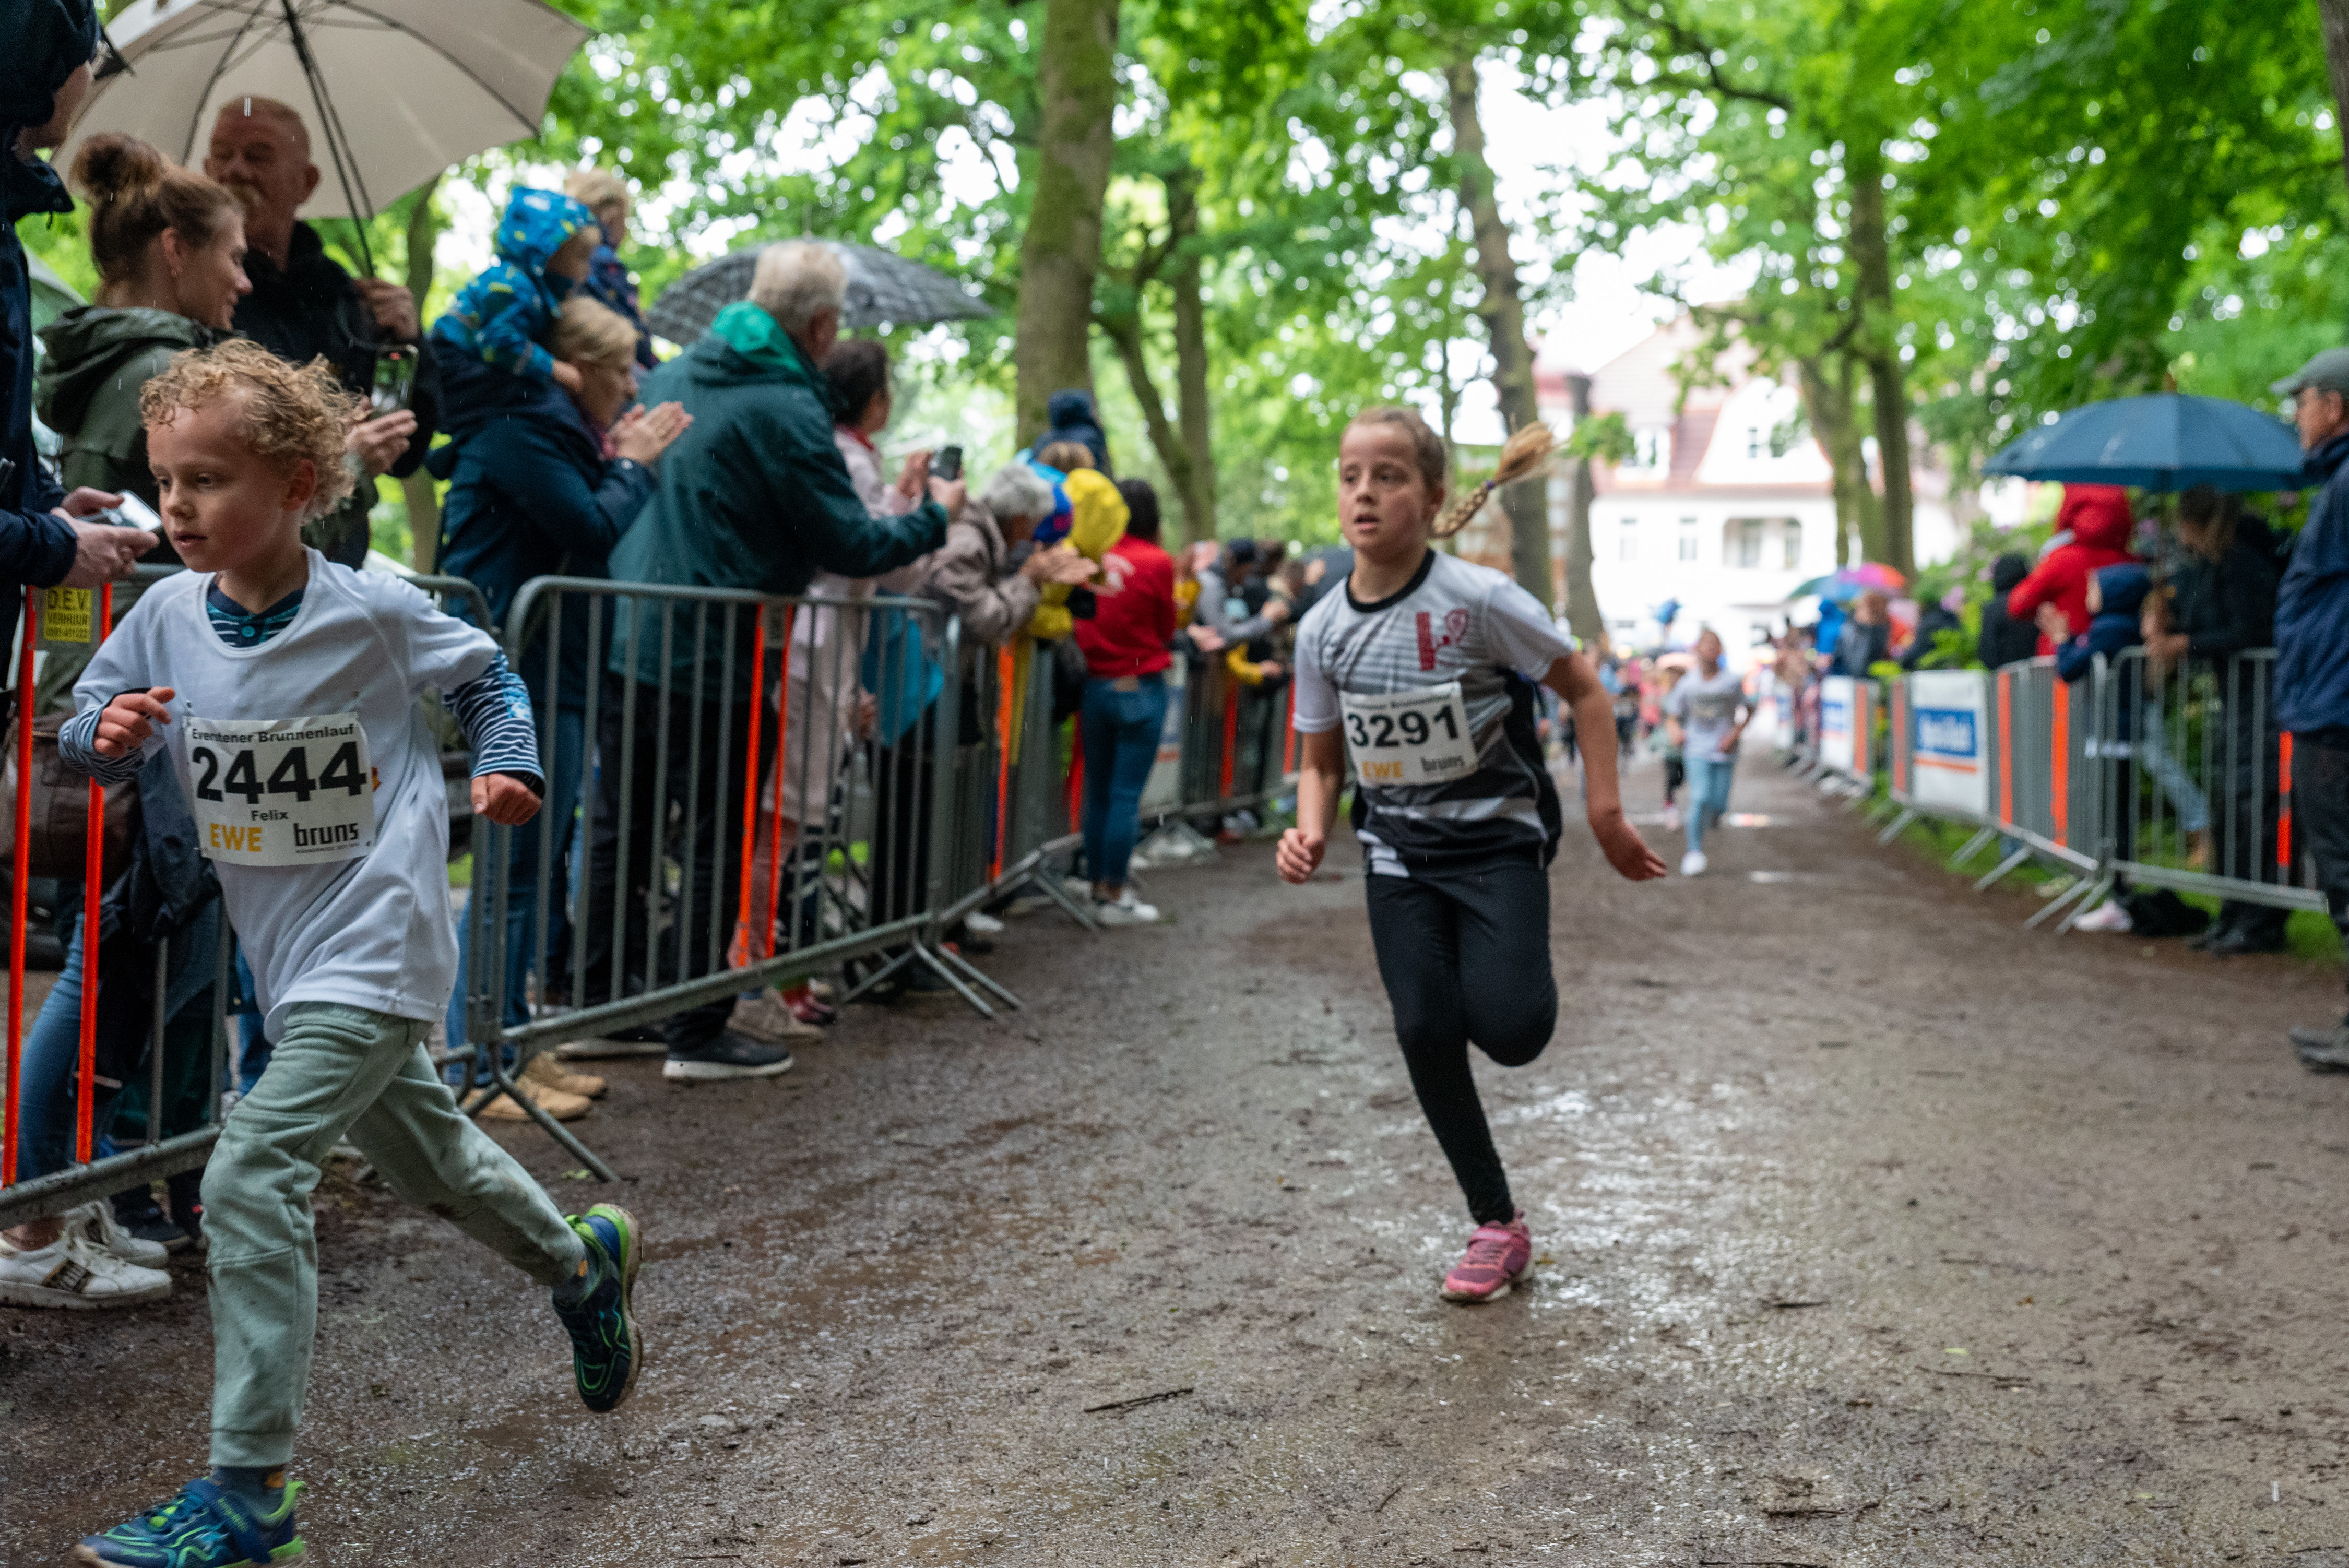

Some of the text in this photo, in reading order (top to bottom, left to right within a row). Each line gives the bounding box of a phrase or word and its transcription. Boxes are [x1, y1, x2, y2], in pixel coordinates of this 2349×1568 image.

[259, 723, 355, 743] Brunnenlauf
[1347, 704, 1458, 747] 3291
[192, 741, 367, 804] 2444
[1362, 760, 1403, 778] EWE
[251, 810, 289, 821] Felix
[210, 822, 262, 852] EWE
[293, 822, 359, 846] bruns
